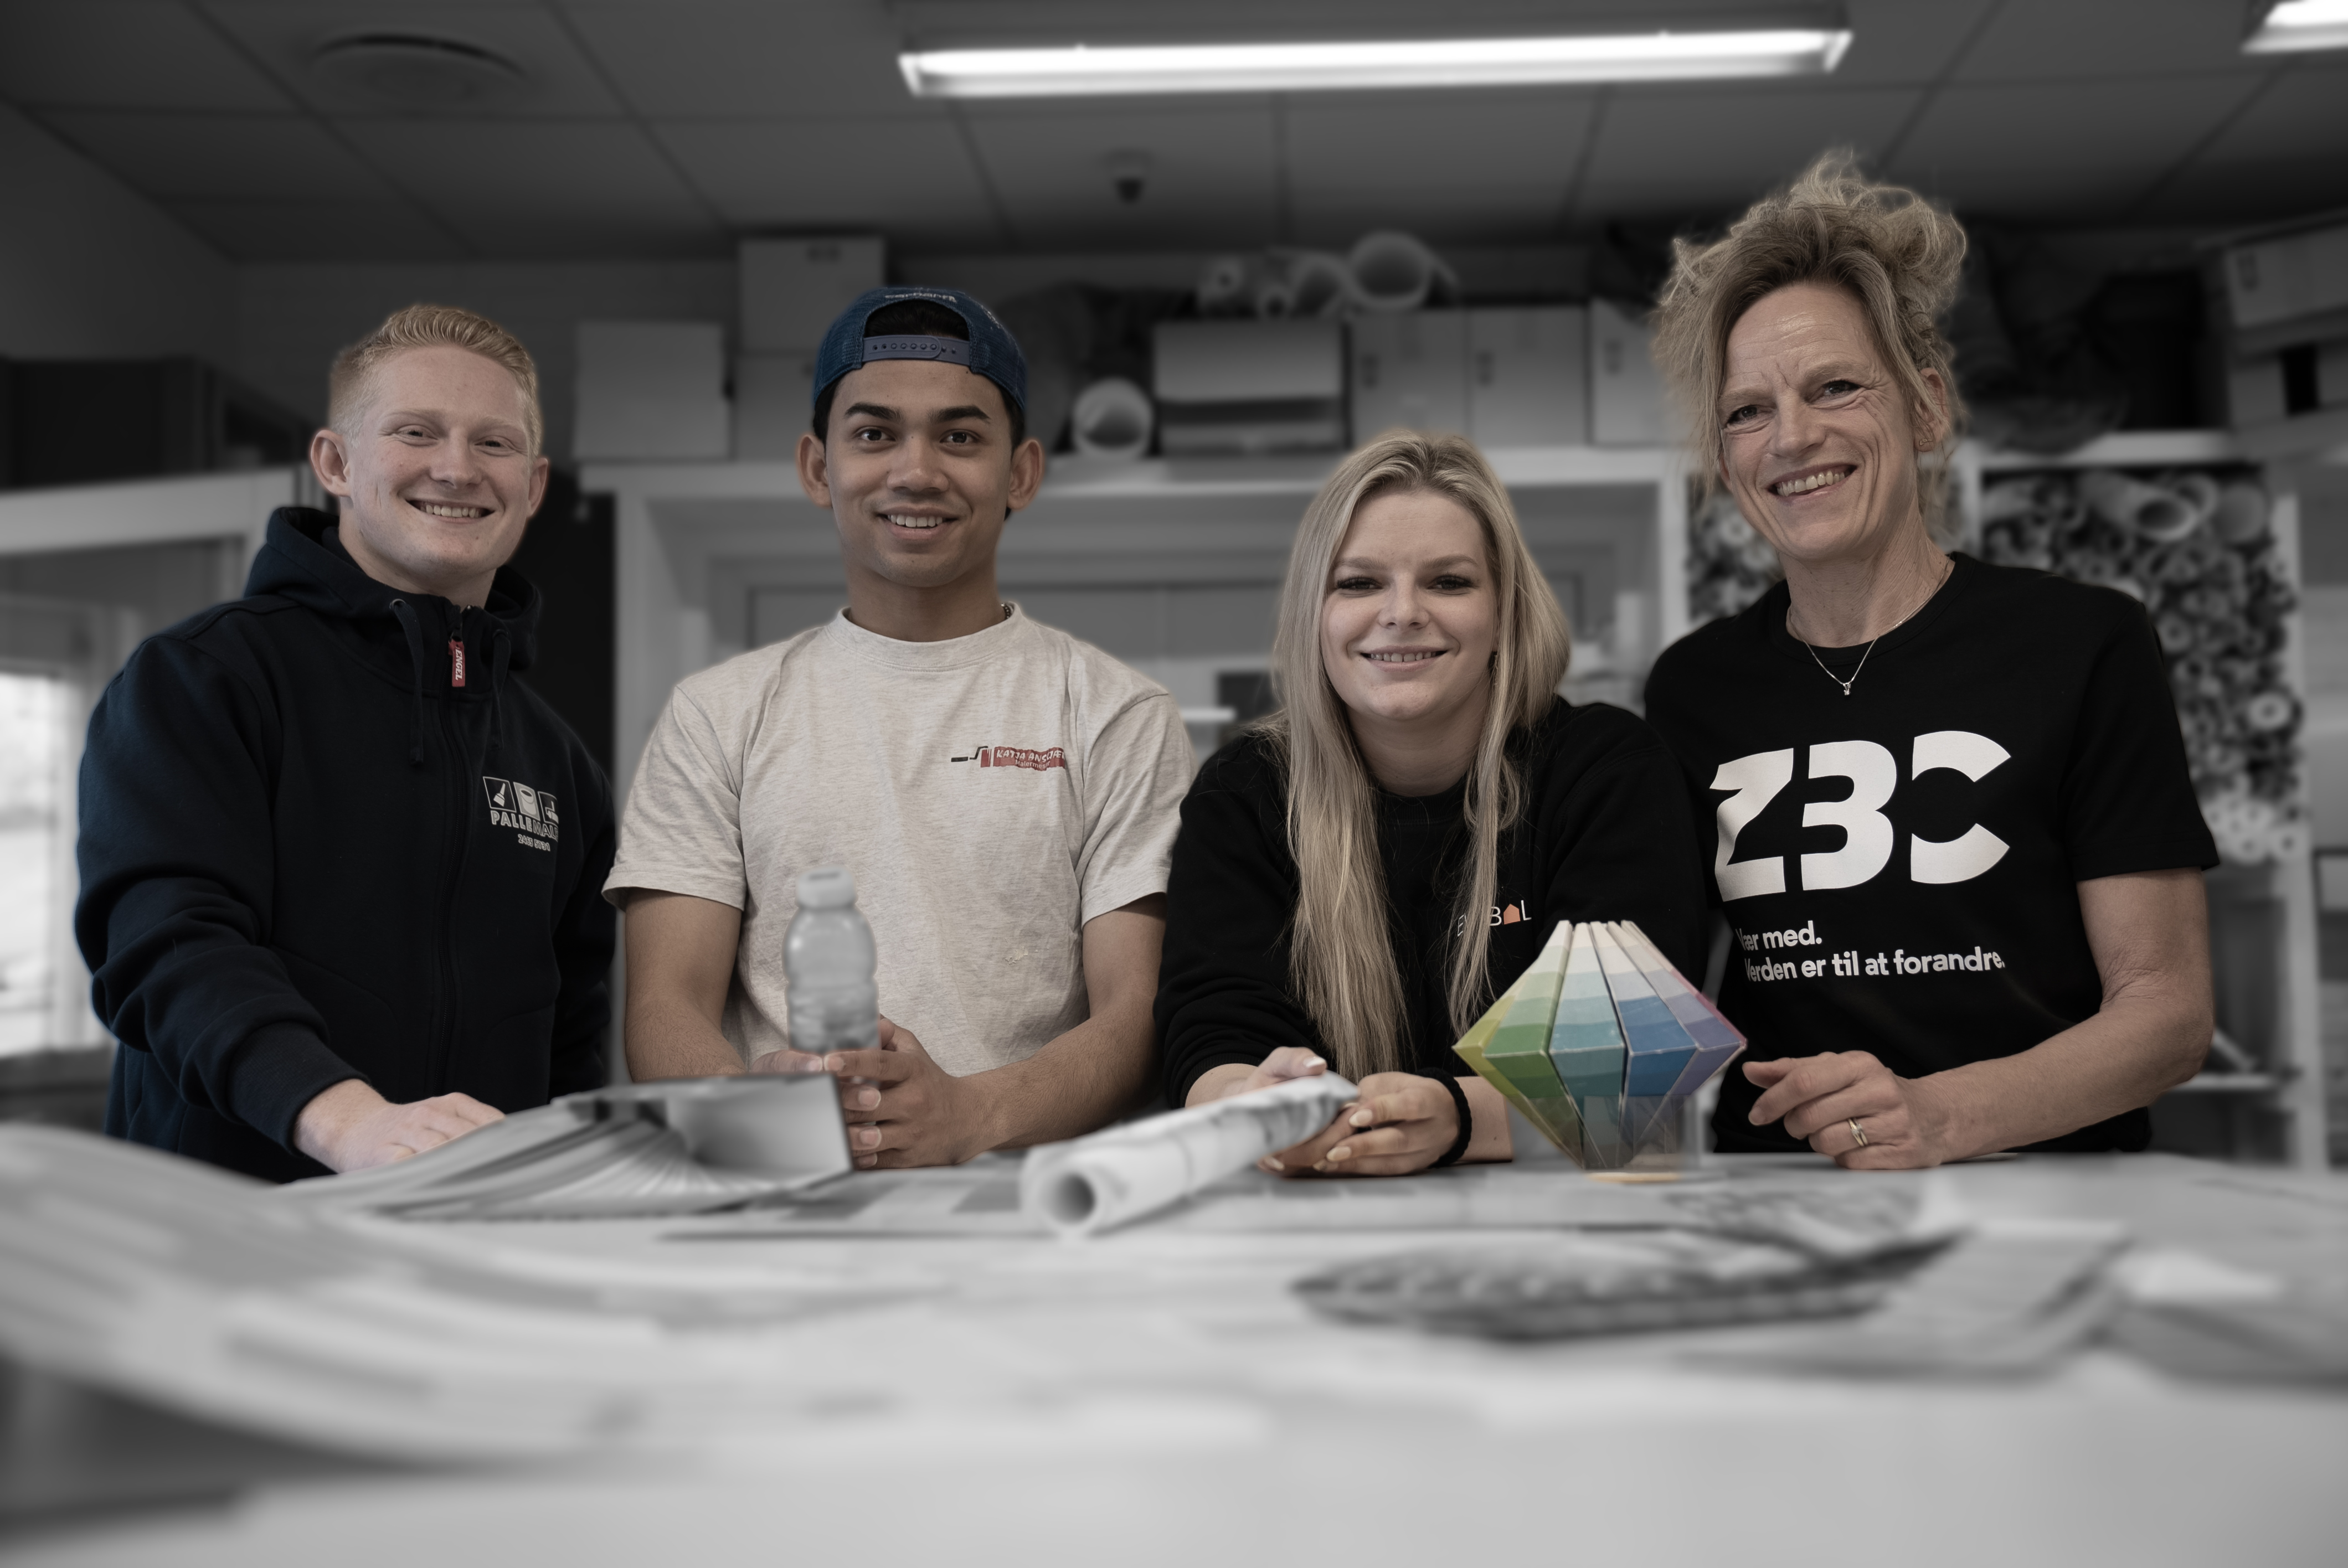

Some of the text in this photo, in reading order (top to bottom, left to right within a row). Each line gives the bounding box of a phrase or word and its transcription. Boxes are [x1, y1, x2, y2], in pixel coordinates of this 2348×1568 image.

[996, 749, 1026, 760] KATJA
[518, 833, 550, 852] 2465 5731
[1735, 920, 1822, 951] Vær med.
[1744, 957, 1798, 982] Verden
[1801, 959, 1826, 977] er
[1831, 951, 1860, 976] til
[1865, 952, 1889, 976] at
